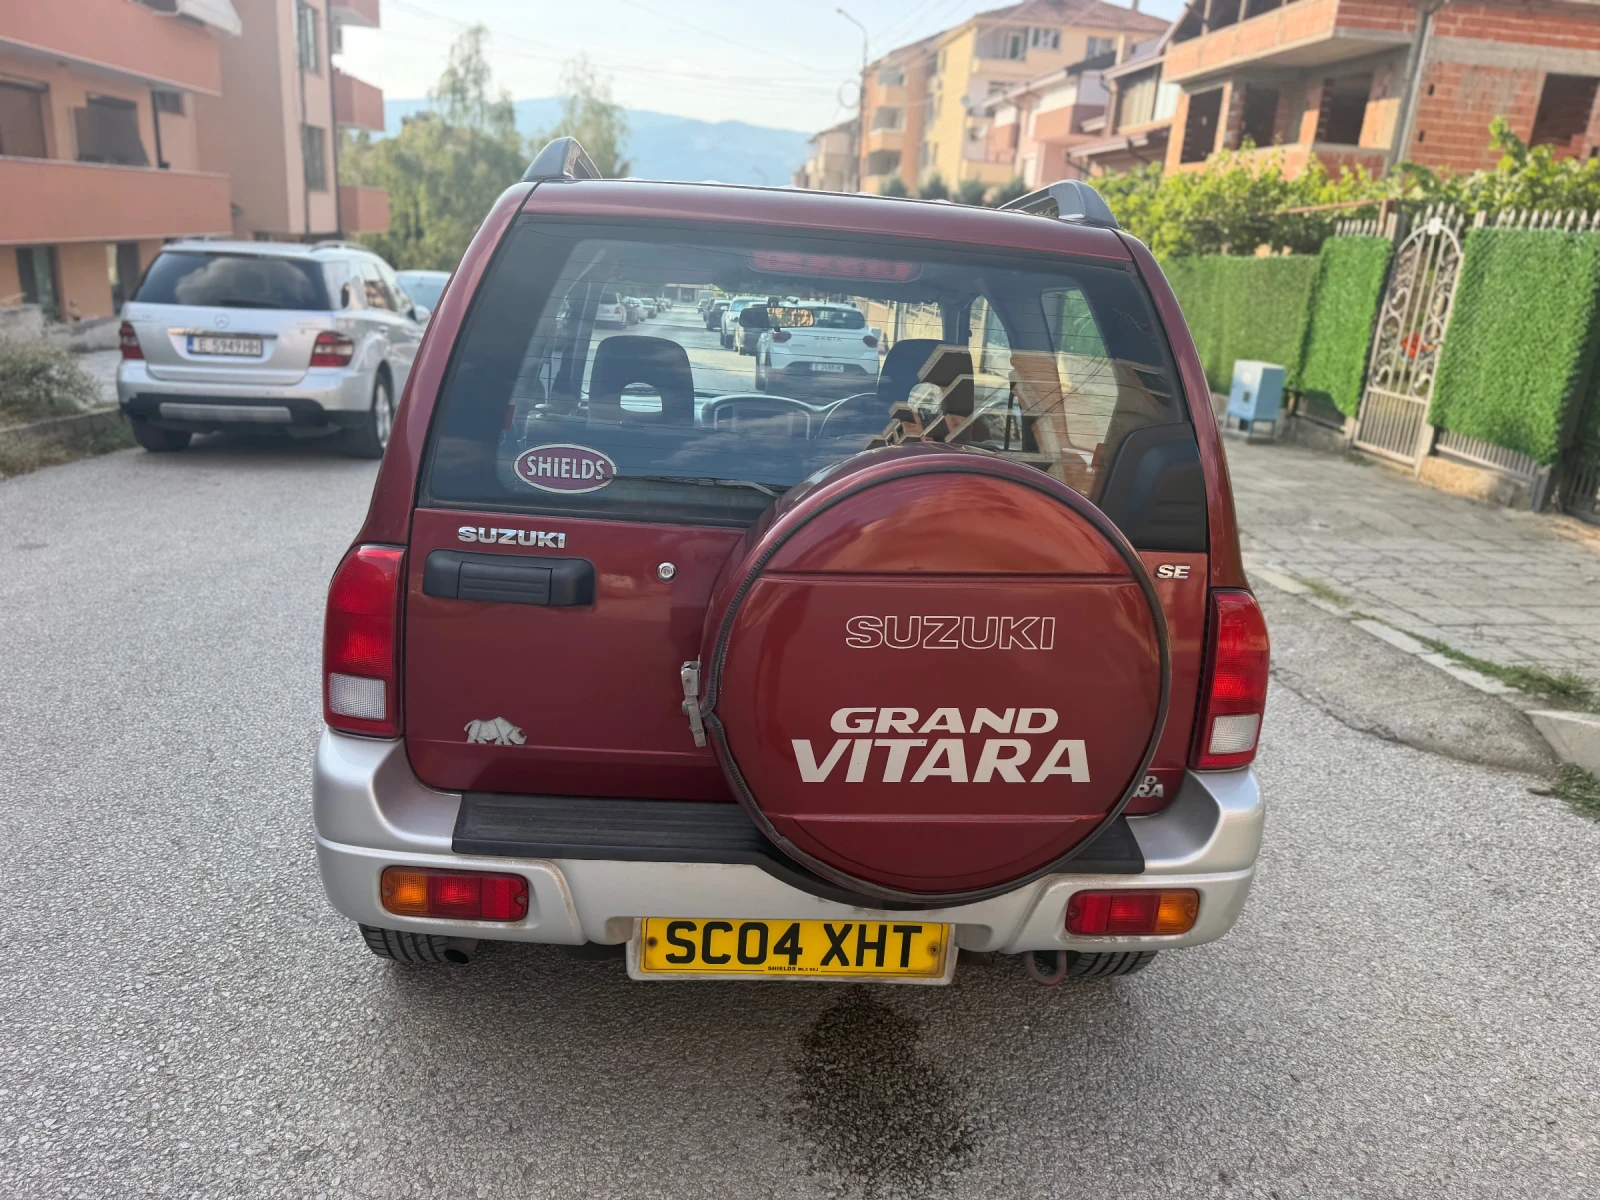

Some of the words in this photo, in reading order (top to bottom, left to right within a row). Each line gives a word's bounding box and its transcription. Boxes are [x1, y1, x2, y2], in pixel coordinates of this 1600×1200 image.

[526, 455, 605, 480] SHIELDS
[457, 526, 566, 549] SUZUKI
[1156, 564, 1191, 580] SE
[845, 614, 1056, 650] SUZUKI
[829, 707, 1059, 734] GRAND
[791, 738, 1091, 783] VITARA
[820, 923, 922, 968] XHT
